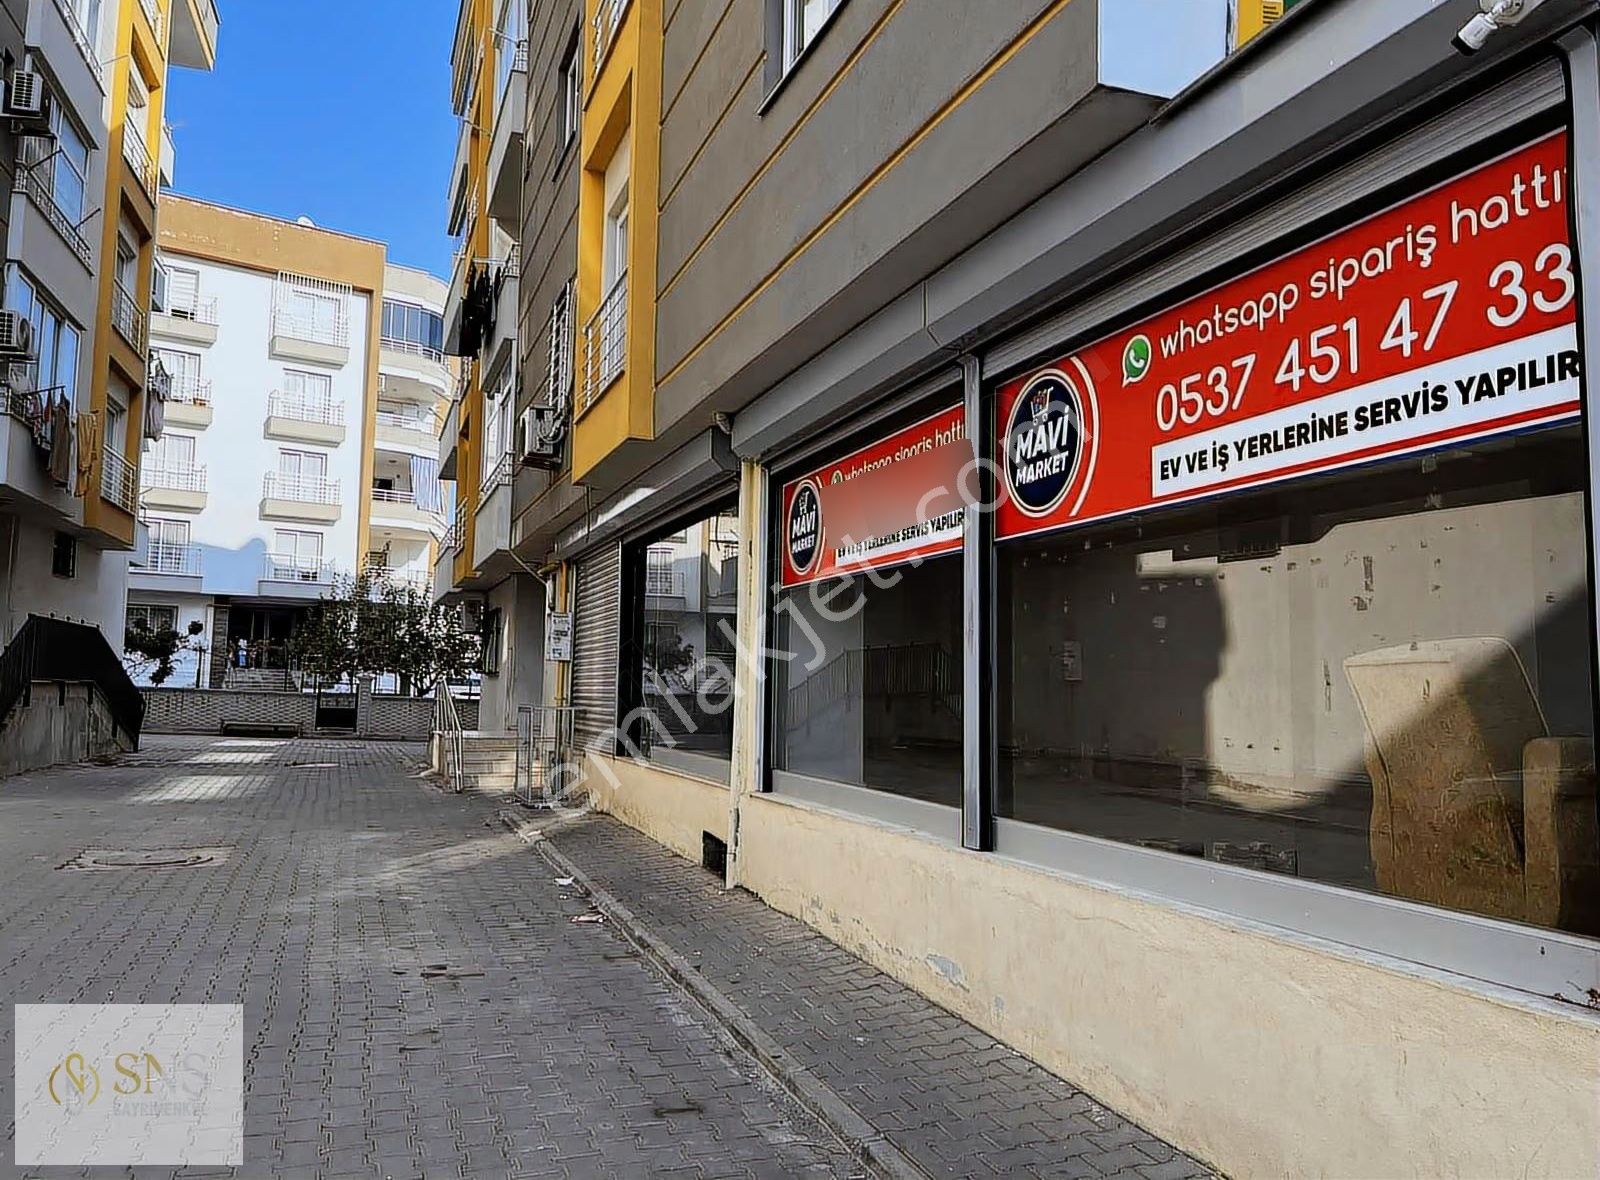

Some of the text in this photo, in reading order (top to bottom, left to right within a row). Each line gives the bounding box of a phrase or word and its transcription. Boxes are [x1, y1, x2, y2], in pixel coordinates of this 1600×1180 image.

[1160, 164, 1561, 358] whatsapp sipariş hattı
[1156, 243, 1574, 432] 0537 451 47 33
[1015, 404, 1070, 464] MAVİ
[1015, 451, 1069, 487] MARKET
[1160, 349, 1580, 480] EV VE İŞ YERLERİNE SERVİS YAPILIR
